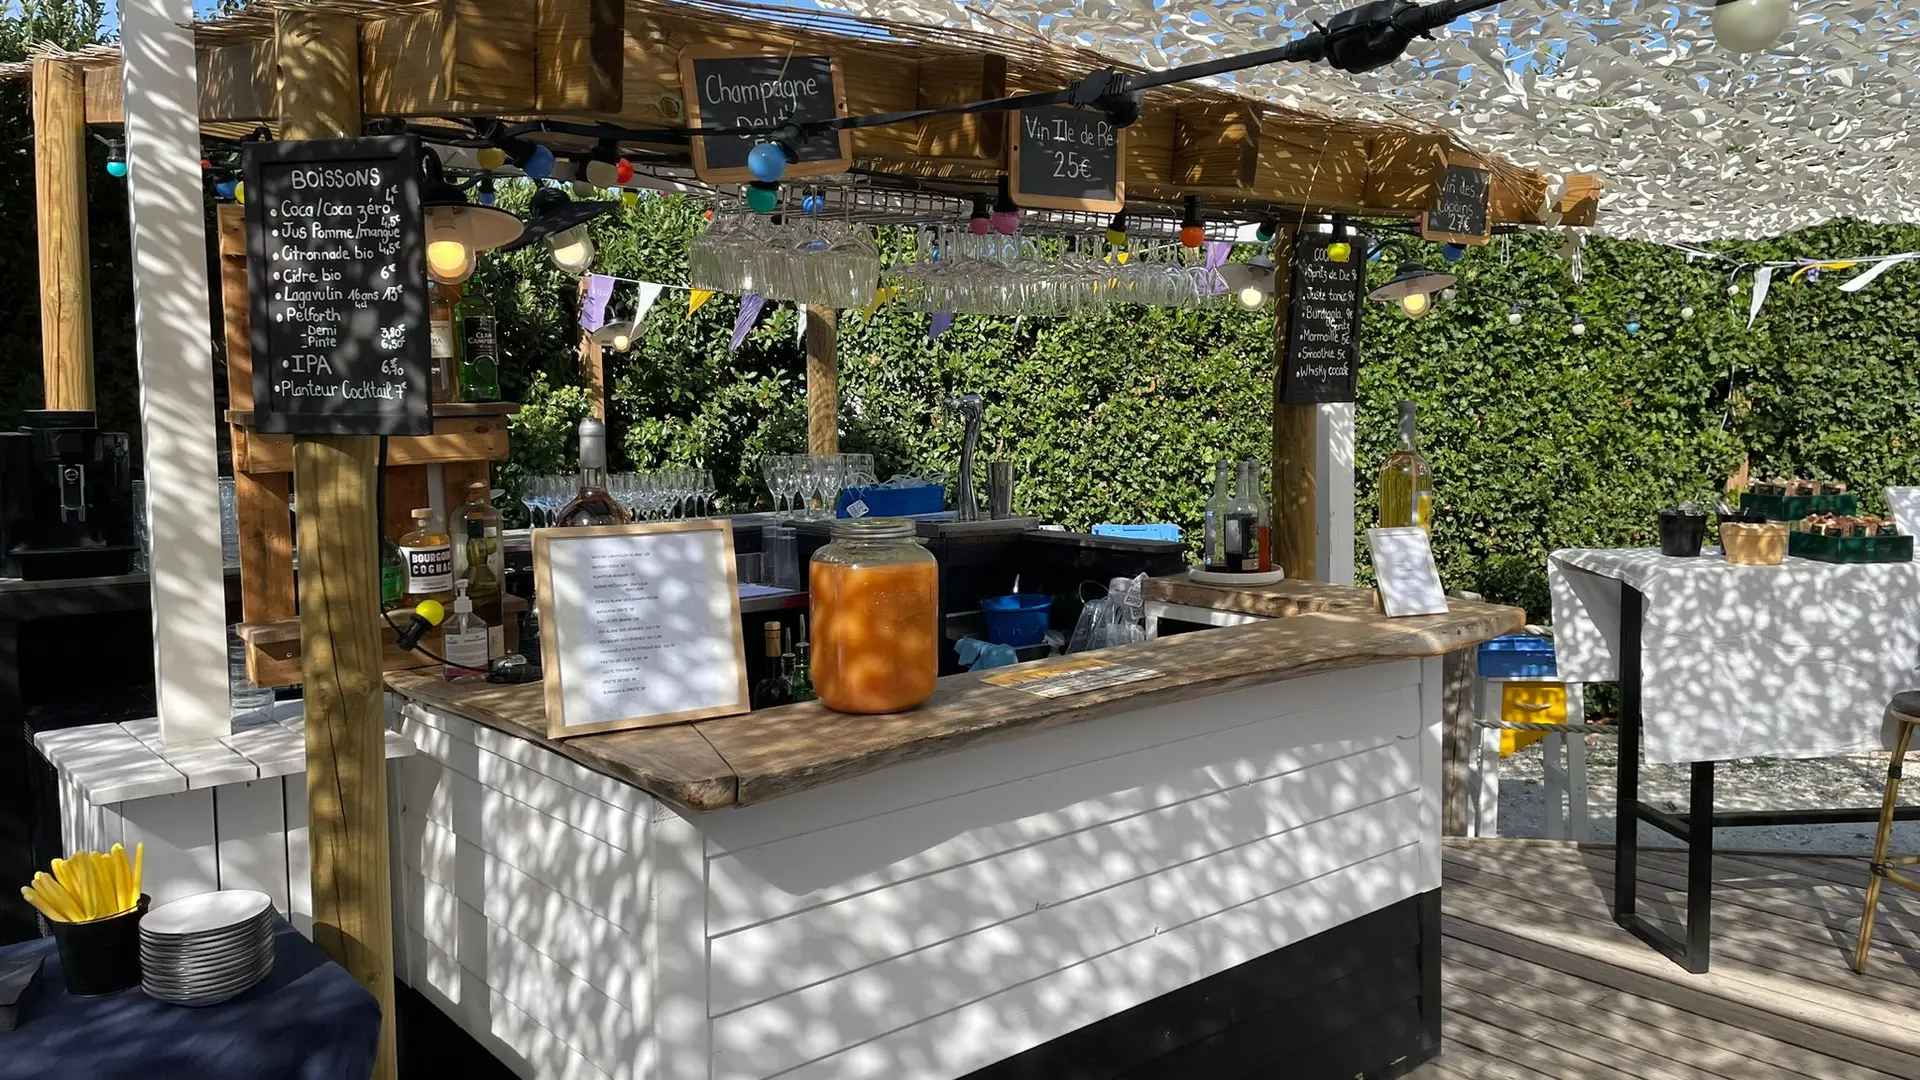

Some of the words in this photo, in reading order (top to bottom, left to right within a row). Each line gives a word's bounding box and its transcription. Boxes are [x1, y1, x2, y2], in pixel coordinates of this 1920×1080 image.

[706, 74, 818, 114] Champagne
[1025, 115, 1049, 140] Vin
[1052, 119, 1075, 142] Ile
[1080, 124, 1095, 145] de
[1097, 120, 1114, 146] Ré
[1053, 151, 1091, 178] 25€
[1460, 179, 1476, 198] des
[281, 198, 352, 217] Coca/Coca
[357, 198, 390, 224] zéro
[385, 185, 399, 204] 4€
[281, 222, 307, 238] Jus
[312, 221, 400, 244] Pomme/mangue
[381, 214, 401, 229] 4,5€
[1448, 213, 1470, 231] 27€
[281, 245, 350, 261] Citronnade
[355, 246, 374, 259] bio
[378, 241, 401, 256] 4,5€
[283, 268, 318, 283] Cidre
[322, 268, 342, 281] bio
[380, 263, 396, 279] 6€
[1307, 263, 1328, 283] Spritz
[1328, 268, 1338, 279] de
[284, 286, 342, 309] Lagavulin
[381, 284, 403, 301] 13€
[286, 307, 341, 323] Pelforth
[307, 324, 337, 336] Demi
[380, 324, 405, 338] 3,80€
[1341, 333, 1350, 345] 5€
[308, 336, 337, 347] Pinte
[1302, 346, 1335, 360] Smoothie
[1337, 349, 1346, 360] 5€
[291, 354, 333, 375] IPA
[281, 380, 338, 397] Planteur
[342, 380, 393, 400] Cocktail
[394, 381, 408, 400] 7€
